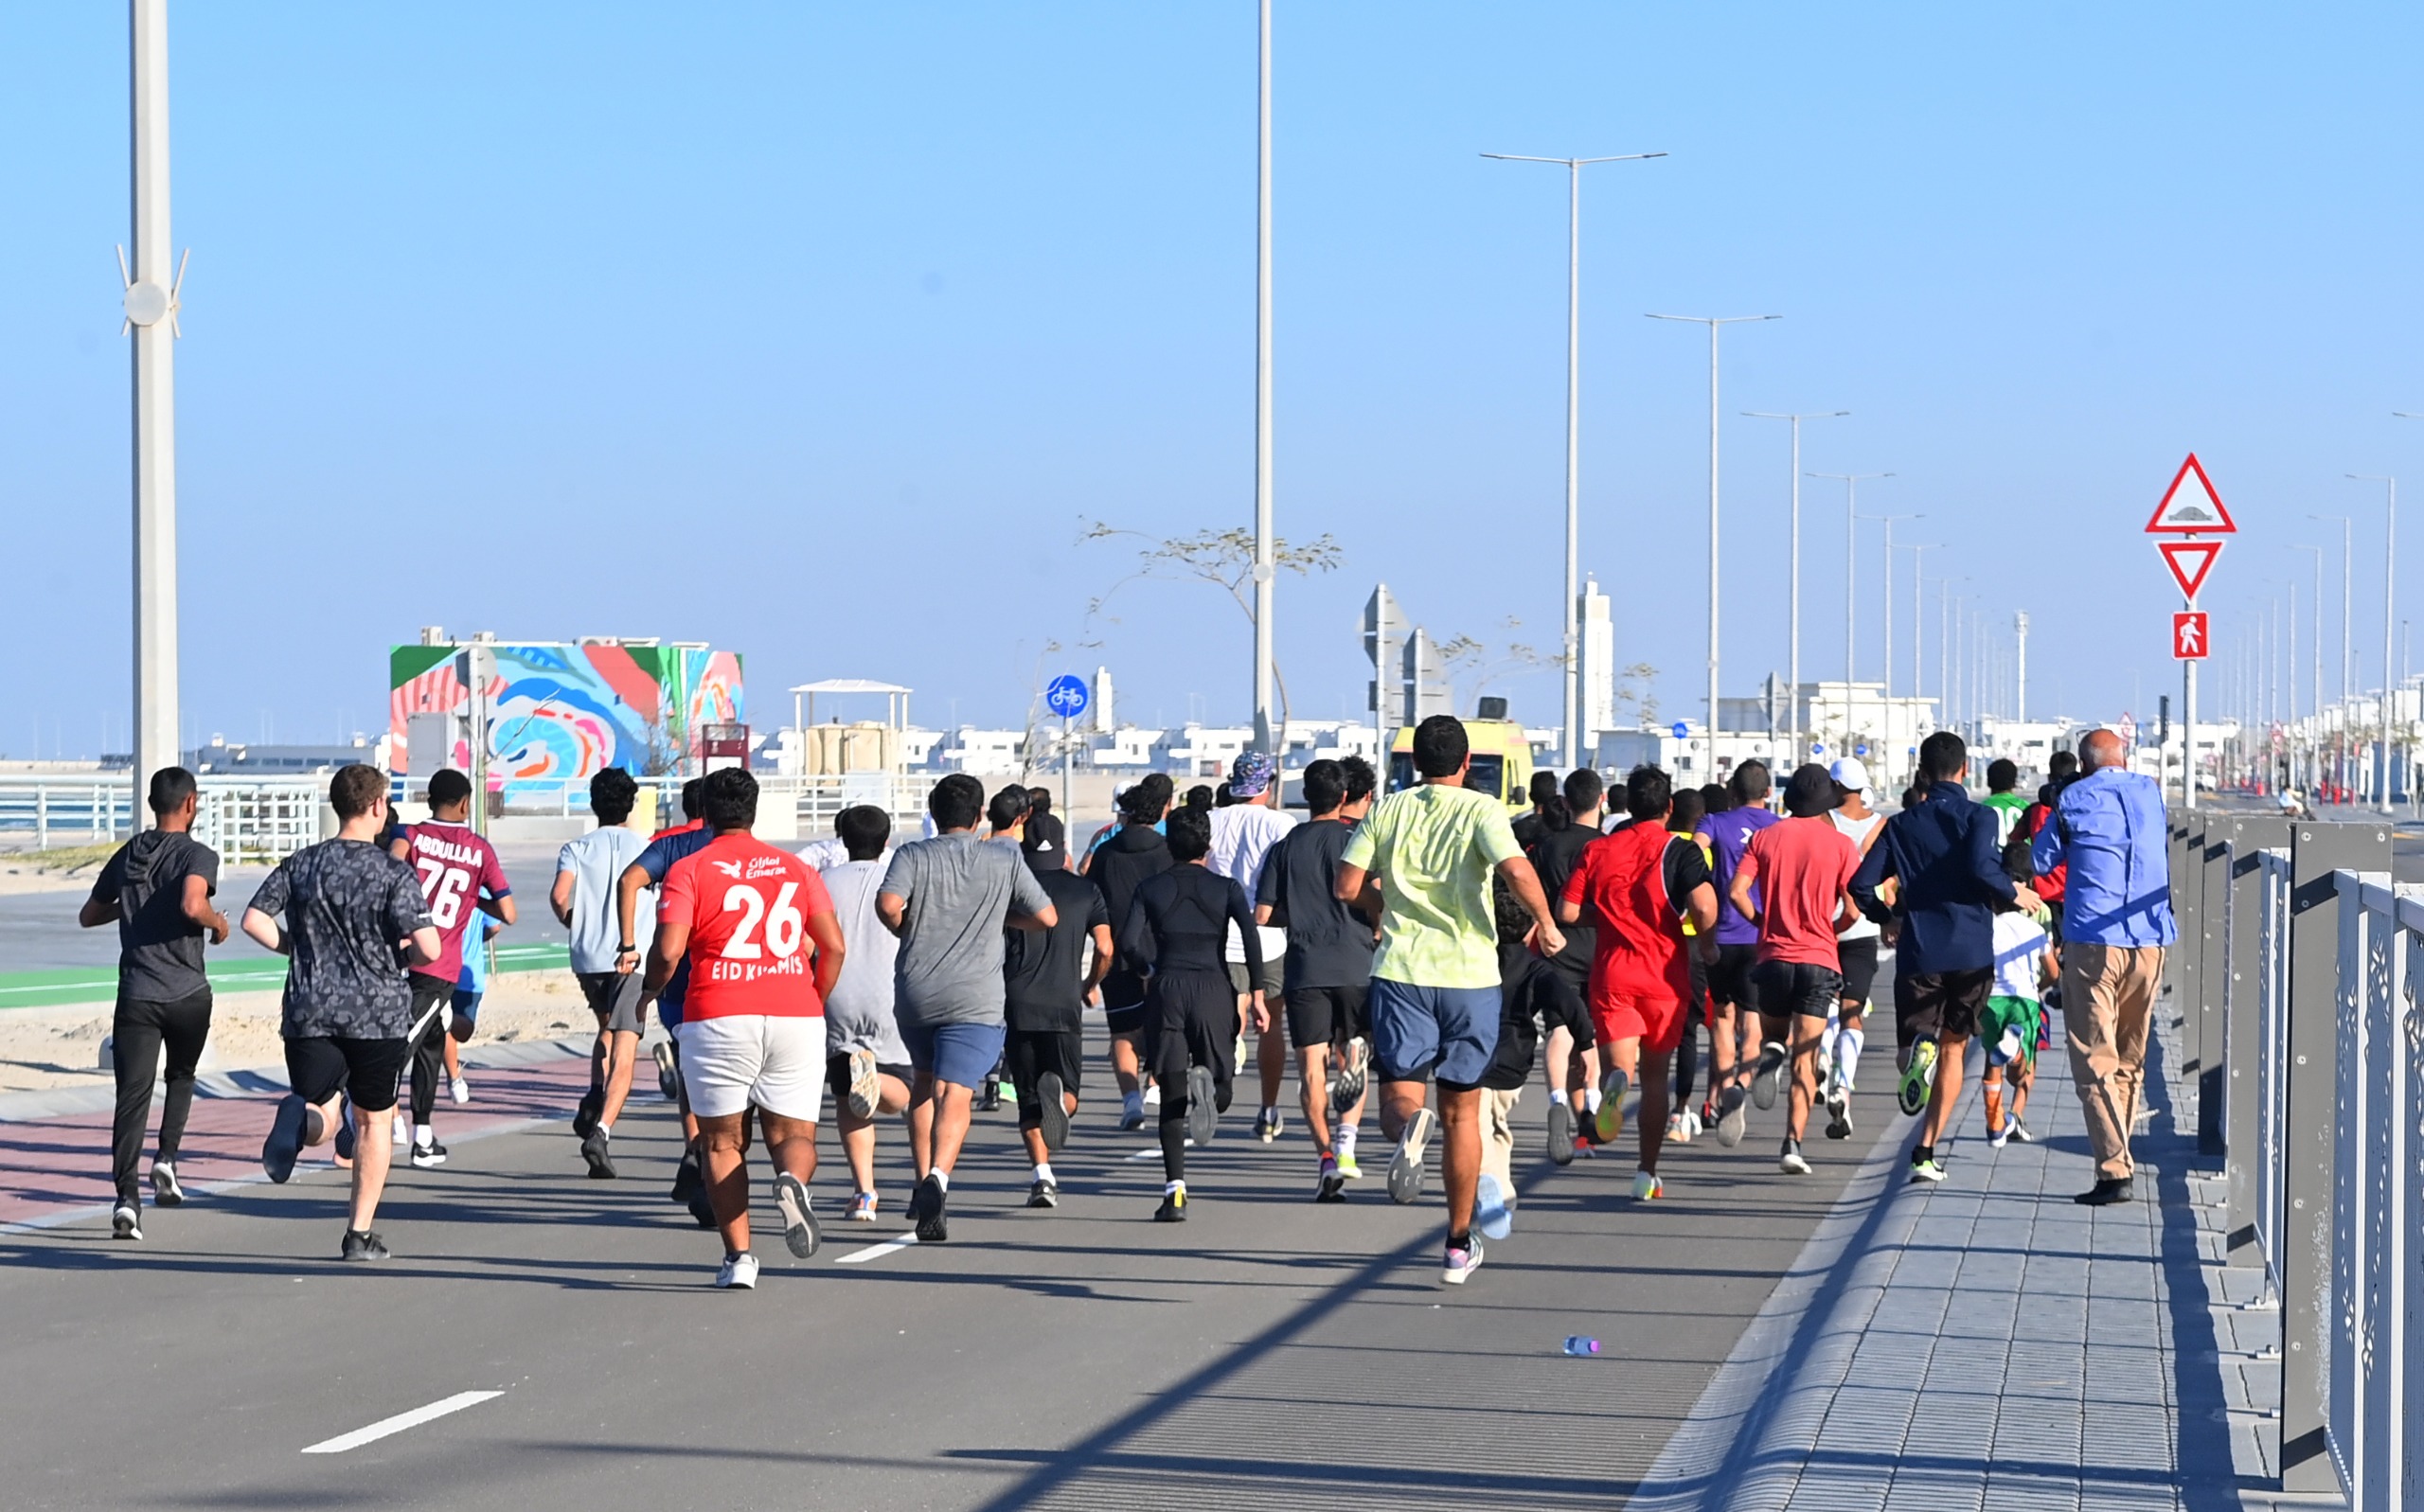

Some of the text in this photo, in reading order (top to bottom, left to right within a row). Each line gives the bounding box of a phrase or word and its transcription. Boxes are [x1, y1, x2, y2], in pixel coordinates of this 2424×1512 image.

[413, 833, 483, 868] ABDULLAA
[745, 866, 787, 881] Emarat
[417, 857, 471, 929] 76
[720, 881, 802, 958] 26
[712, 961, 743, 981] EID
